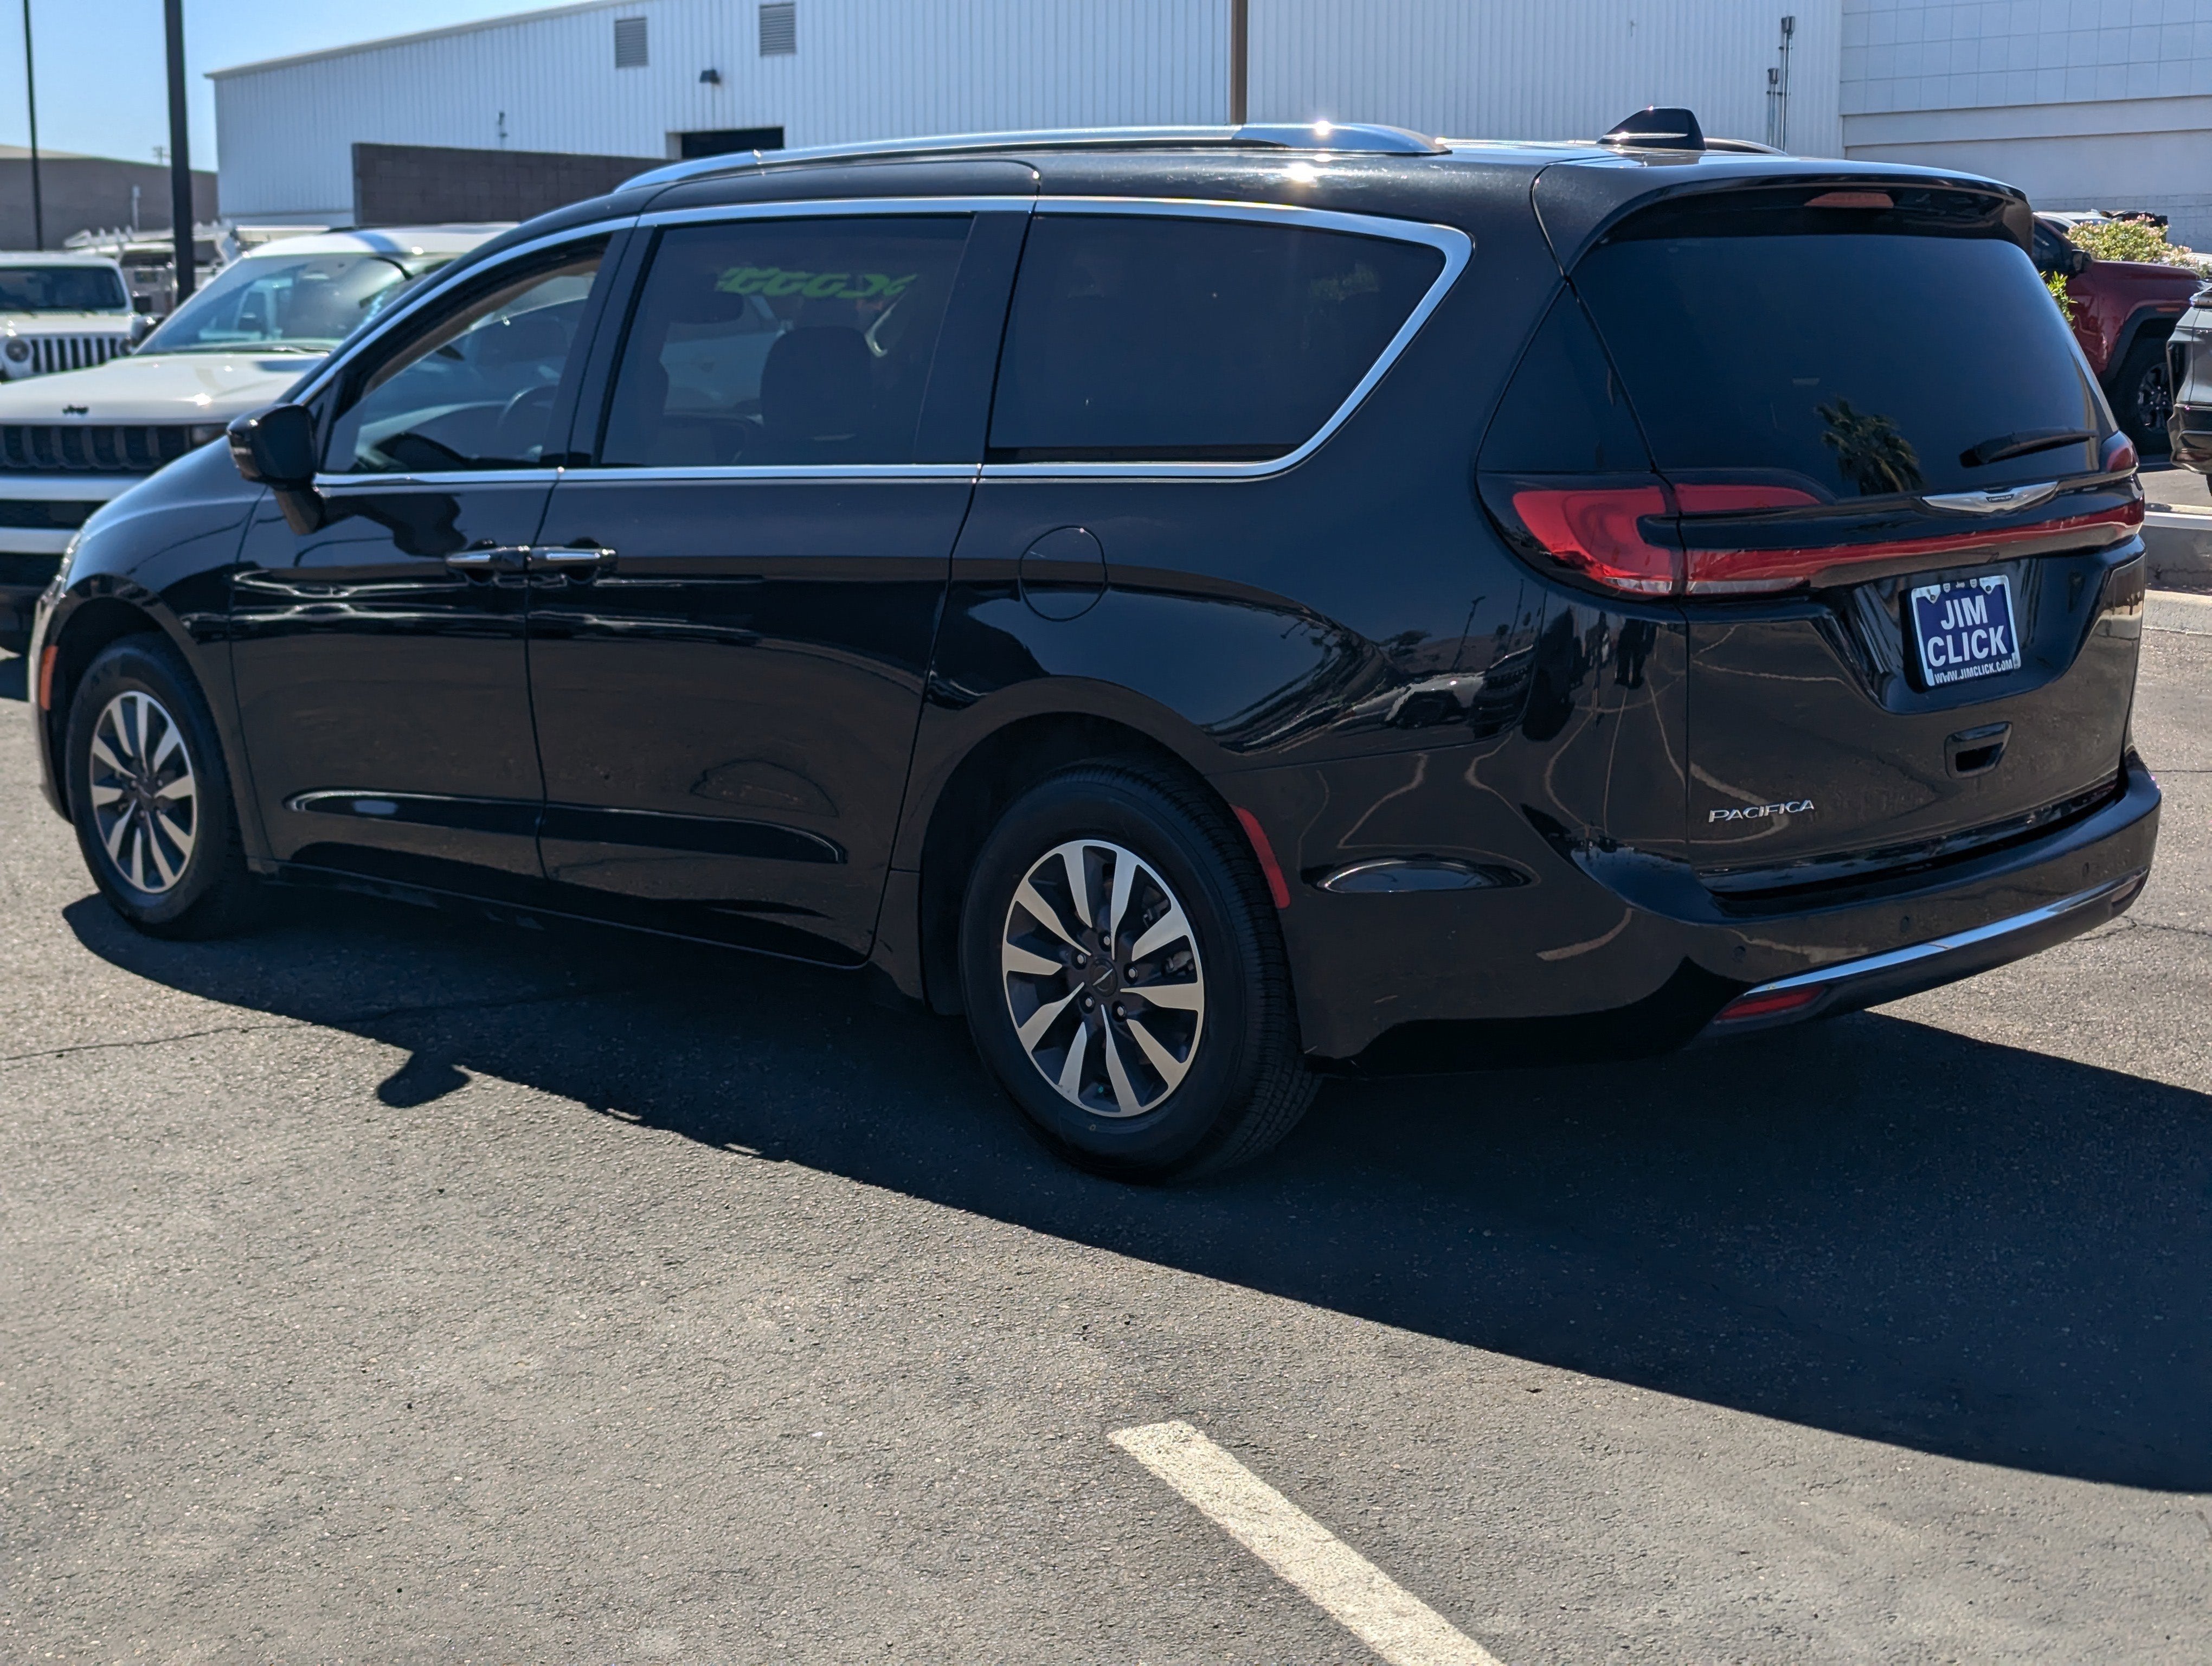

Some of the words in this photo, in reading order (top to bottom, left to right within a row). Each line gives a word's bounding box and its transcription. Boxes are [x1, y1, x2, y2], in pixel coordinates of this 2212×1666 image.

[1940, 595, 1988, 630] JIM
[1927, 625, 2008, 667] CLICK
[1934, 659, 2013, 684] WWW.JIMCLICK.COM
[1708, 799, 1815, 823] PACIFICA
